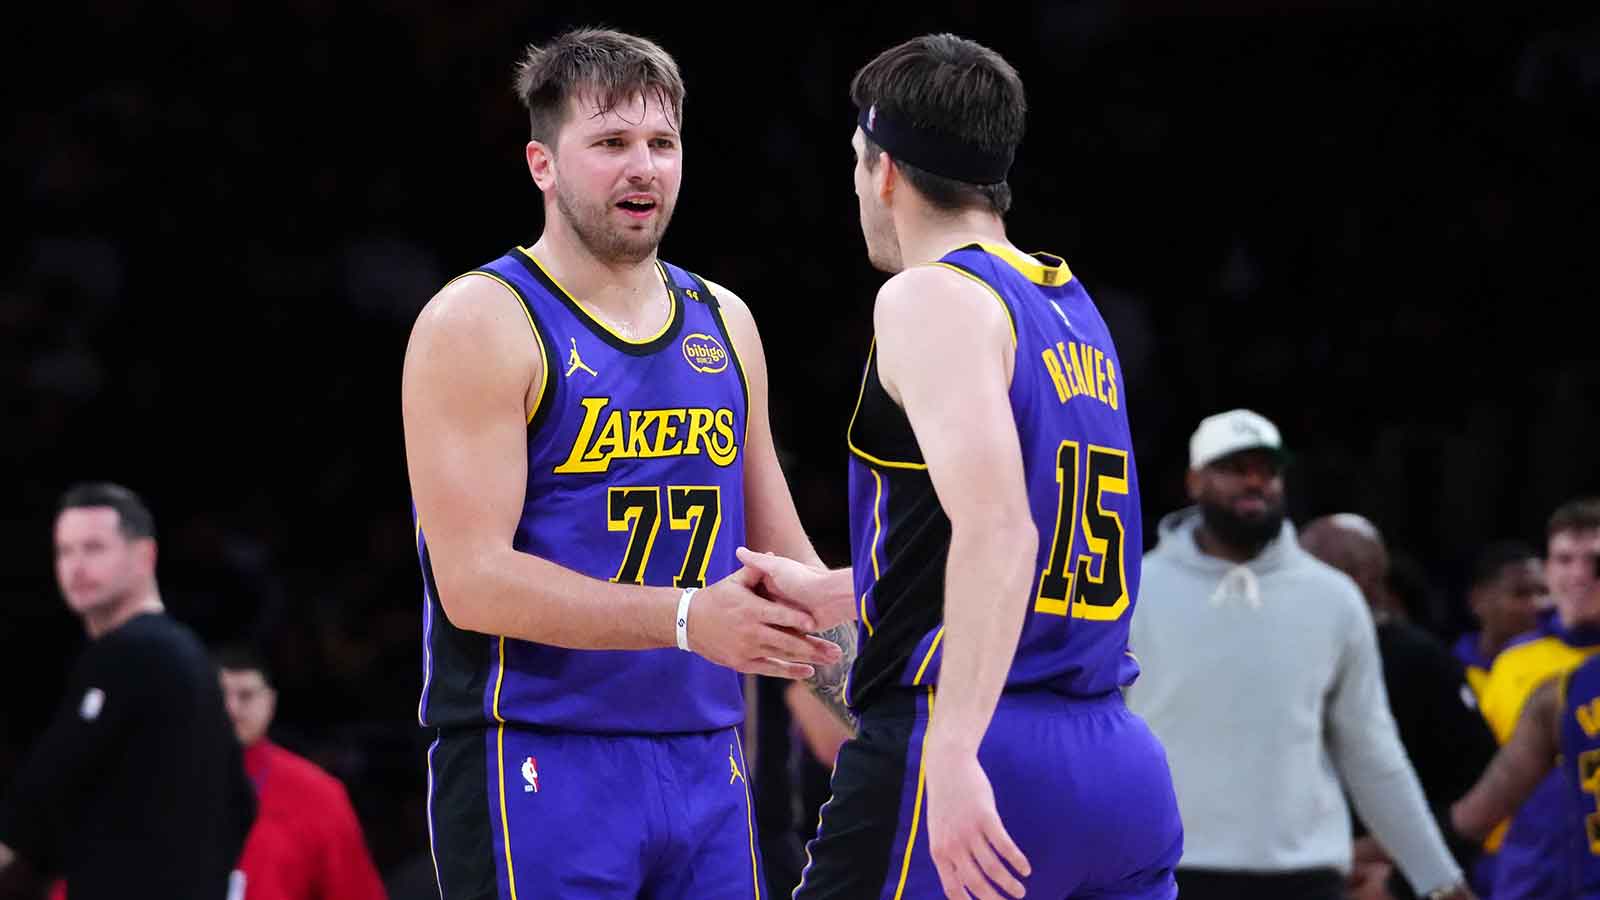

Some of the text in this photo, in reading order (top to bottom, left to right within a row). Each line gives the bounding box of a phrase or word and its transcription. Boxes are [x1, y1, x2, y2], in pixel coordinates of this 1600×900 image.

[686, 344, 725, 362] bibigo
[1042, 341, 1118, 410] REAVES
[553, 397, 738, 474] LAKERS
[607, 485, 721, 587] 77
[1035, 440, 1129, 620] 15
